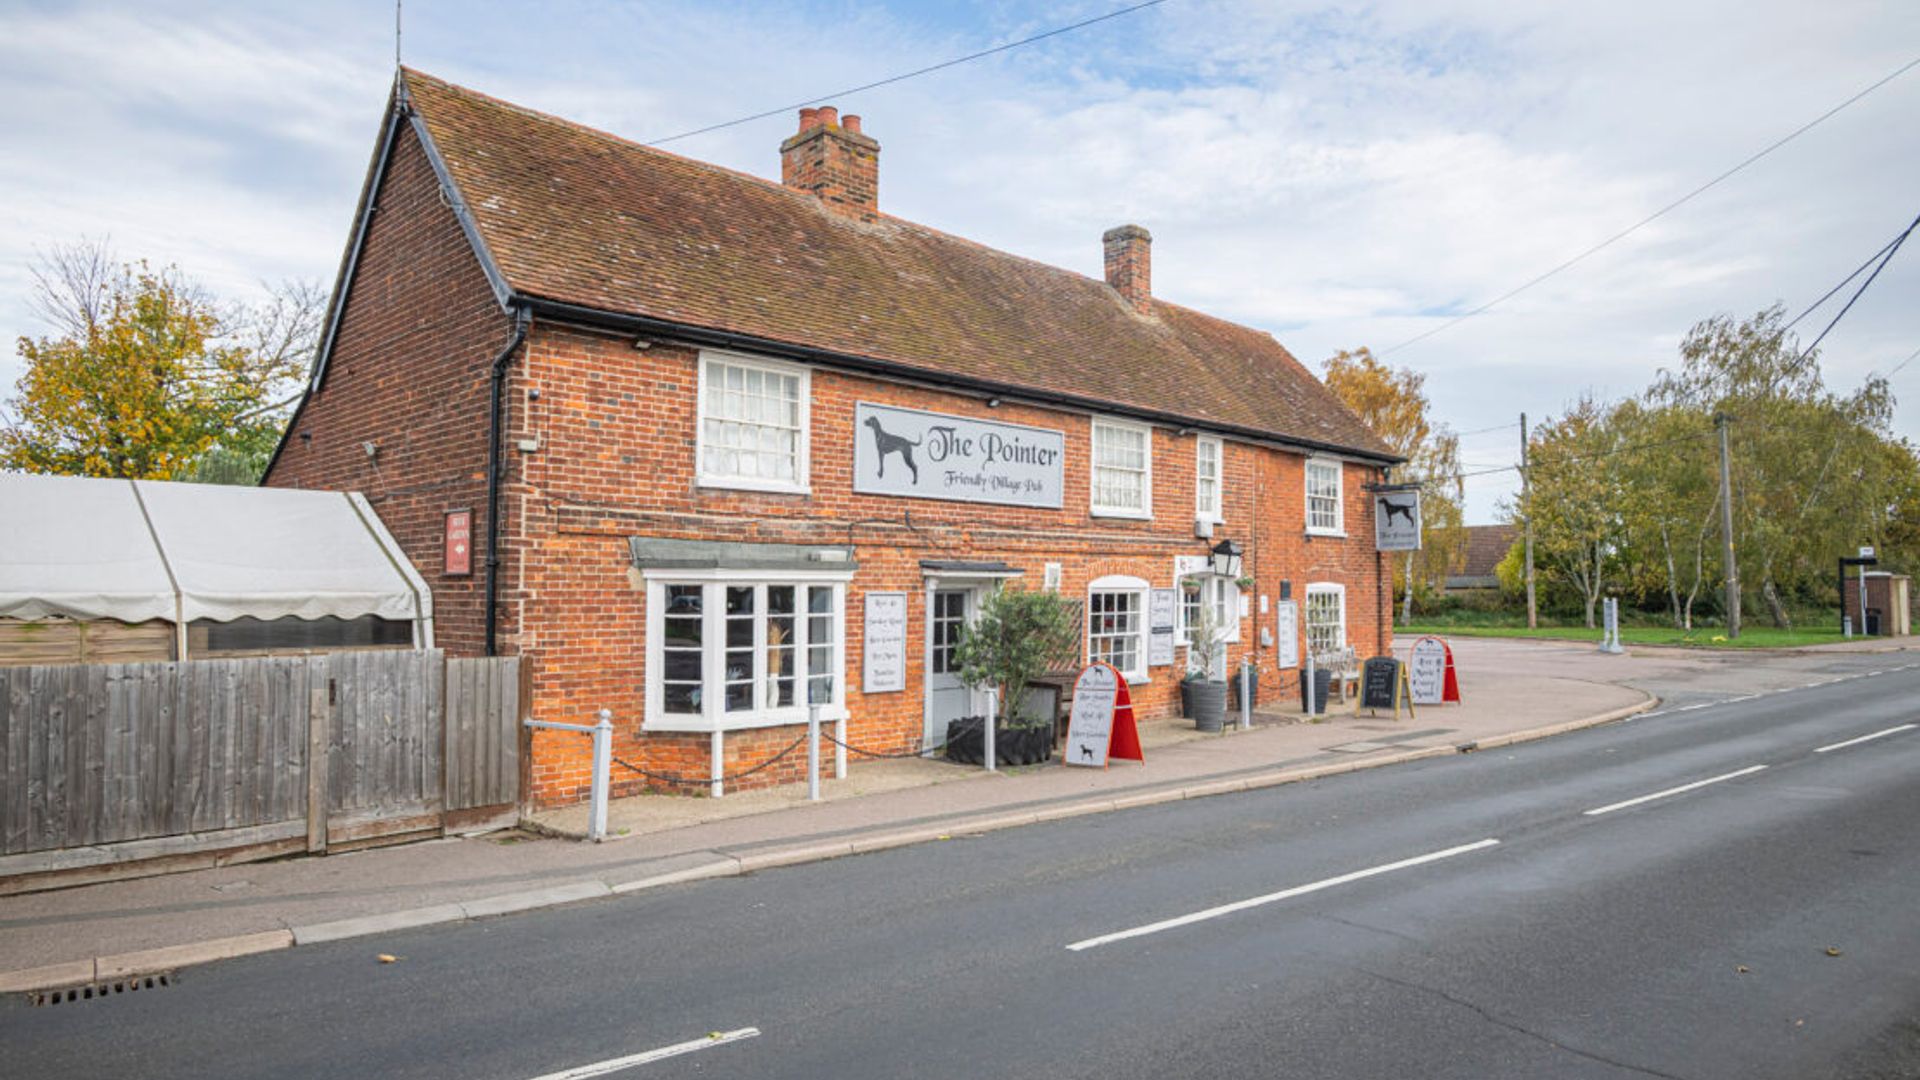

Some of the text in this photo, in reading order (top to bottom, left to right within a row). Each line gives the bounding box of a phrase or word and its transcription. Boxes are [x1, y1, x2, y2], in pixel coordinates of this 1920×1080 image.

[927, 425, 1058, 471] The Pointer
[944, 470, 1043, 494] Friendly Village Pub
